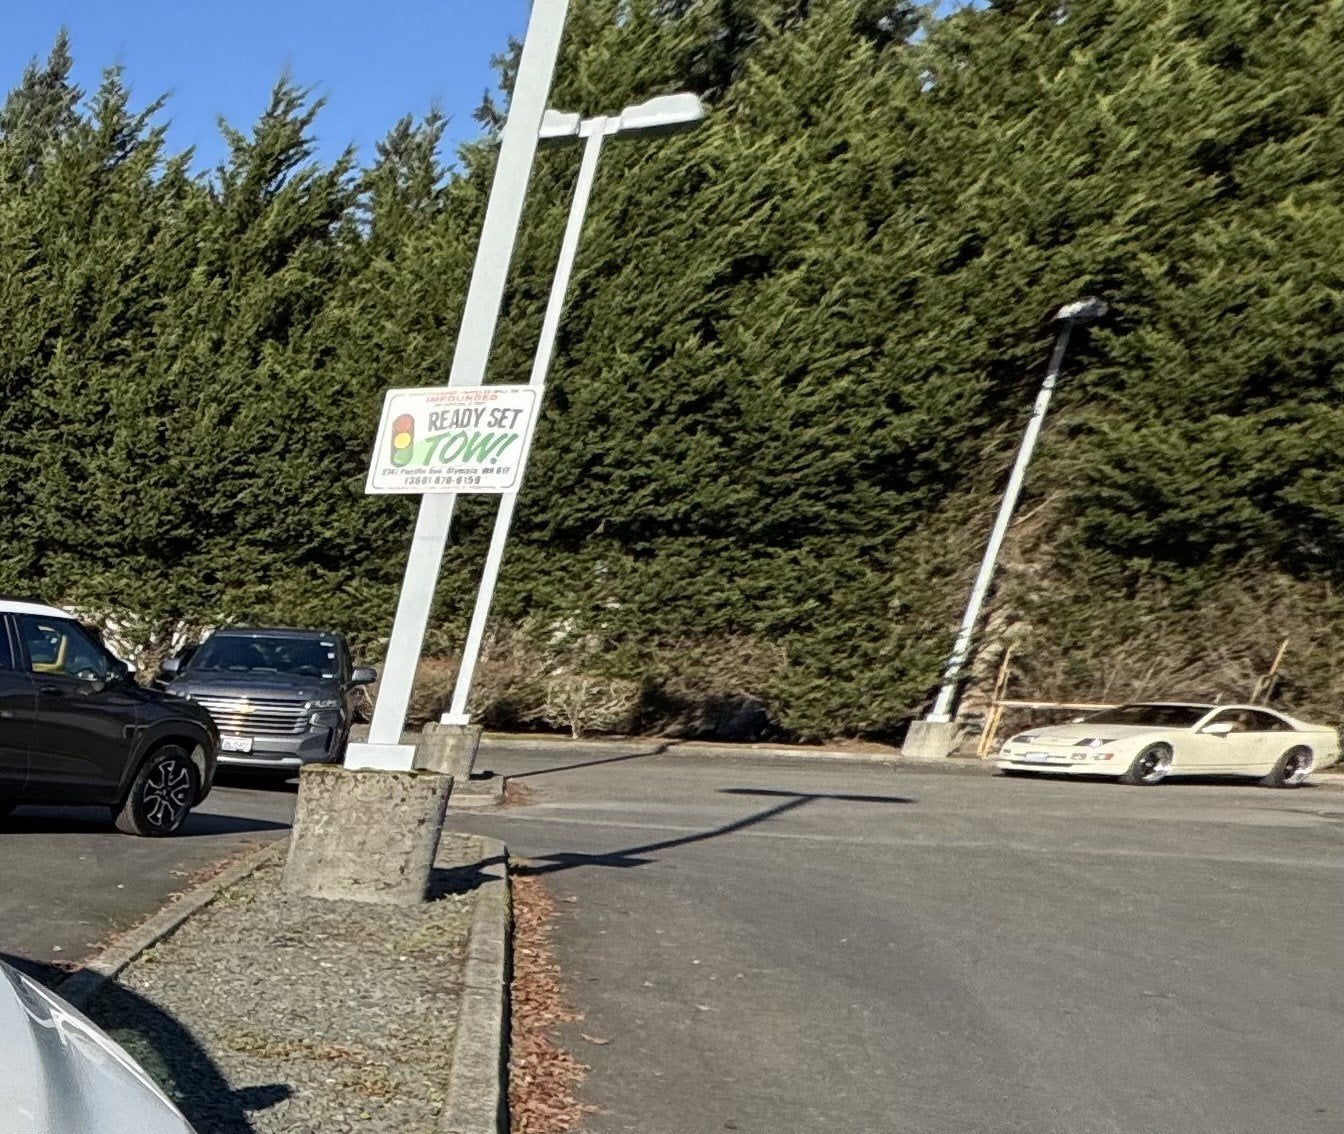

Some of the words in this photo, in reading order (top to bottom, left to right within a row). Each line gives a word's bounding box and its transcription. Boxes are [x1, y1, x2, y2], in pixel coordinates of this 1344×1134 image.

[428, 407, 486, 432] READY
[487, 407, 524, 430] SET
[423, 430, 519, 466] TOW!
